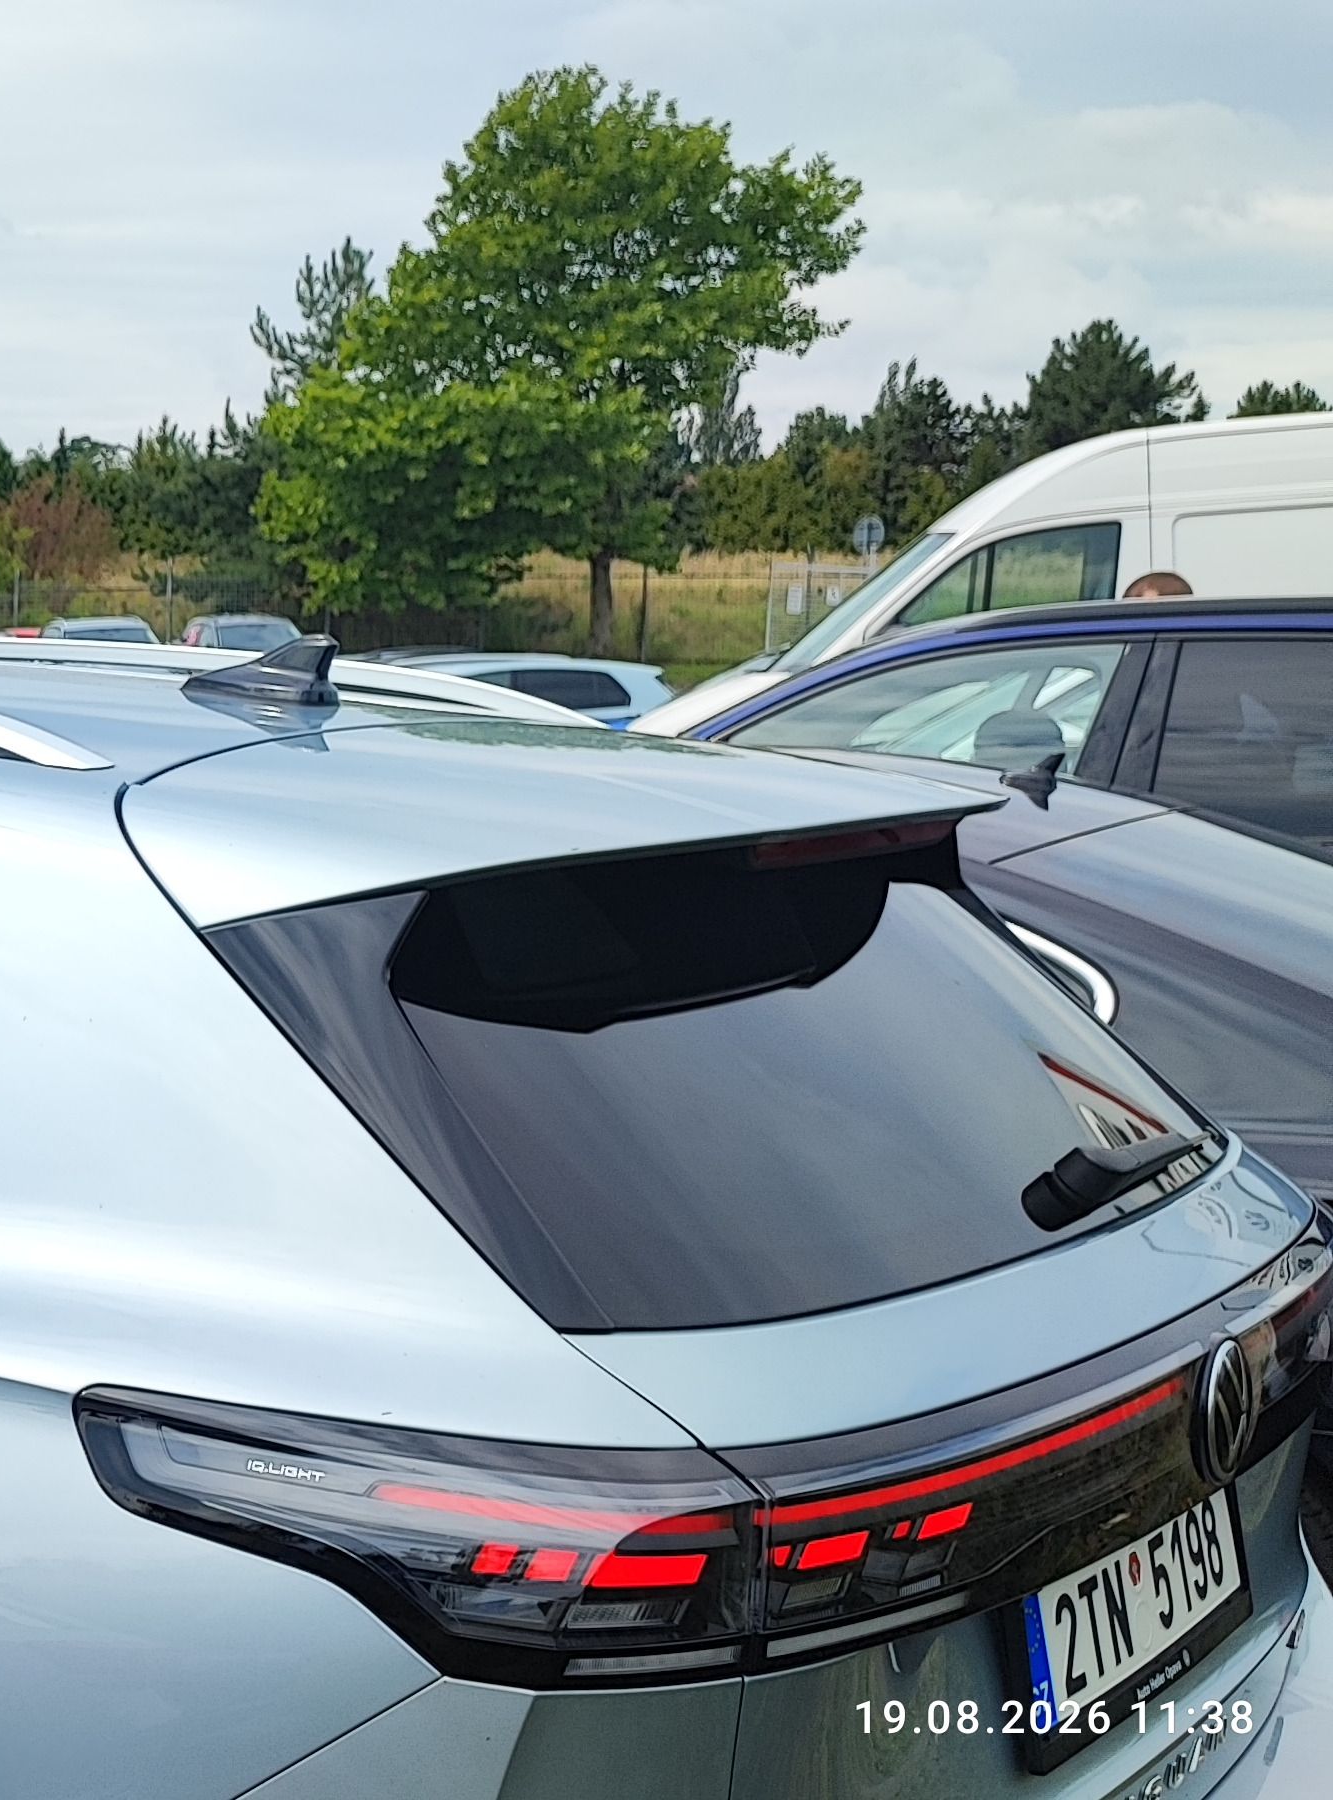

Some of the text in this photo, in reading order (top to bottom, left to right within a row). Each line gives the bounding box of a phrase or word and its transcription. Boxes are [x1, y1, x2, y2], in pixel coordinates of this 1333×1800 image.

[246, 1459, 326, 1483] IQ.LIGHT
[1055, 1496, 1224, 1699] 2TN 5198
